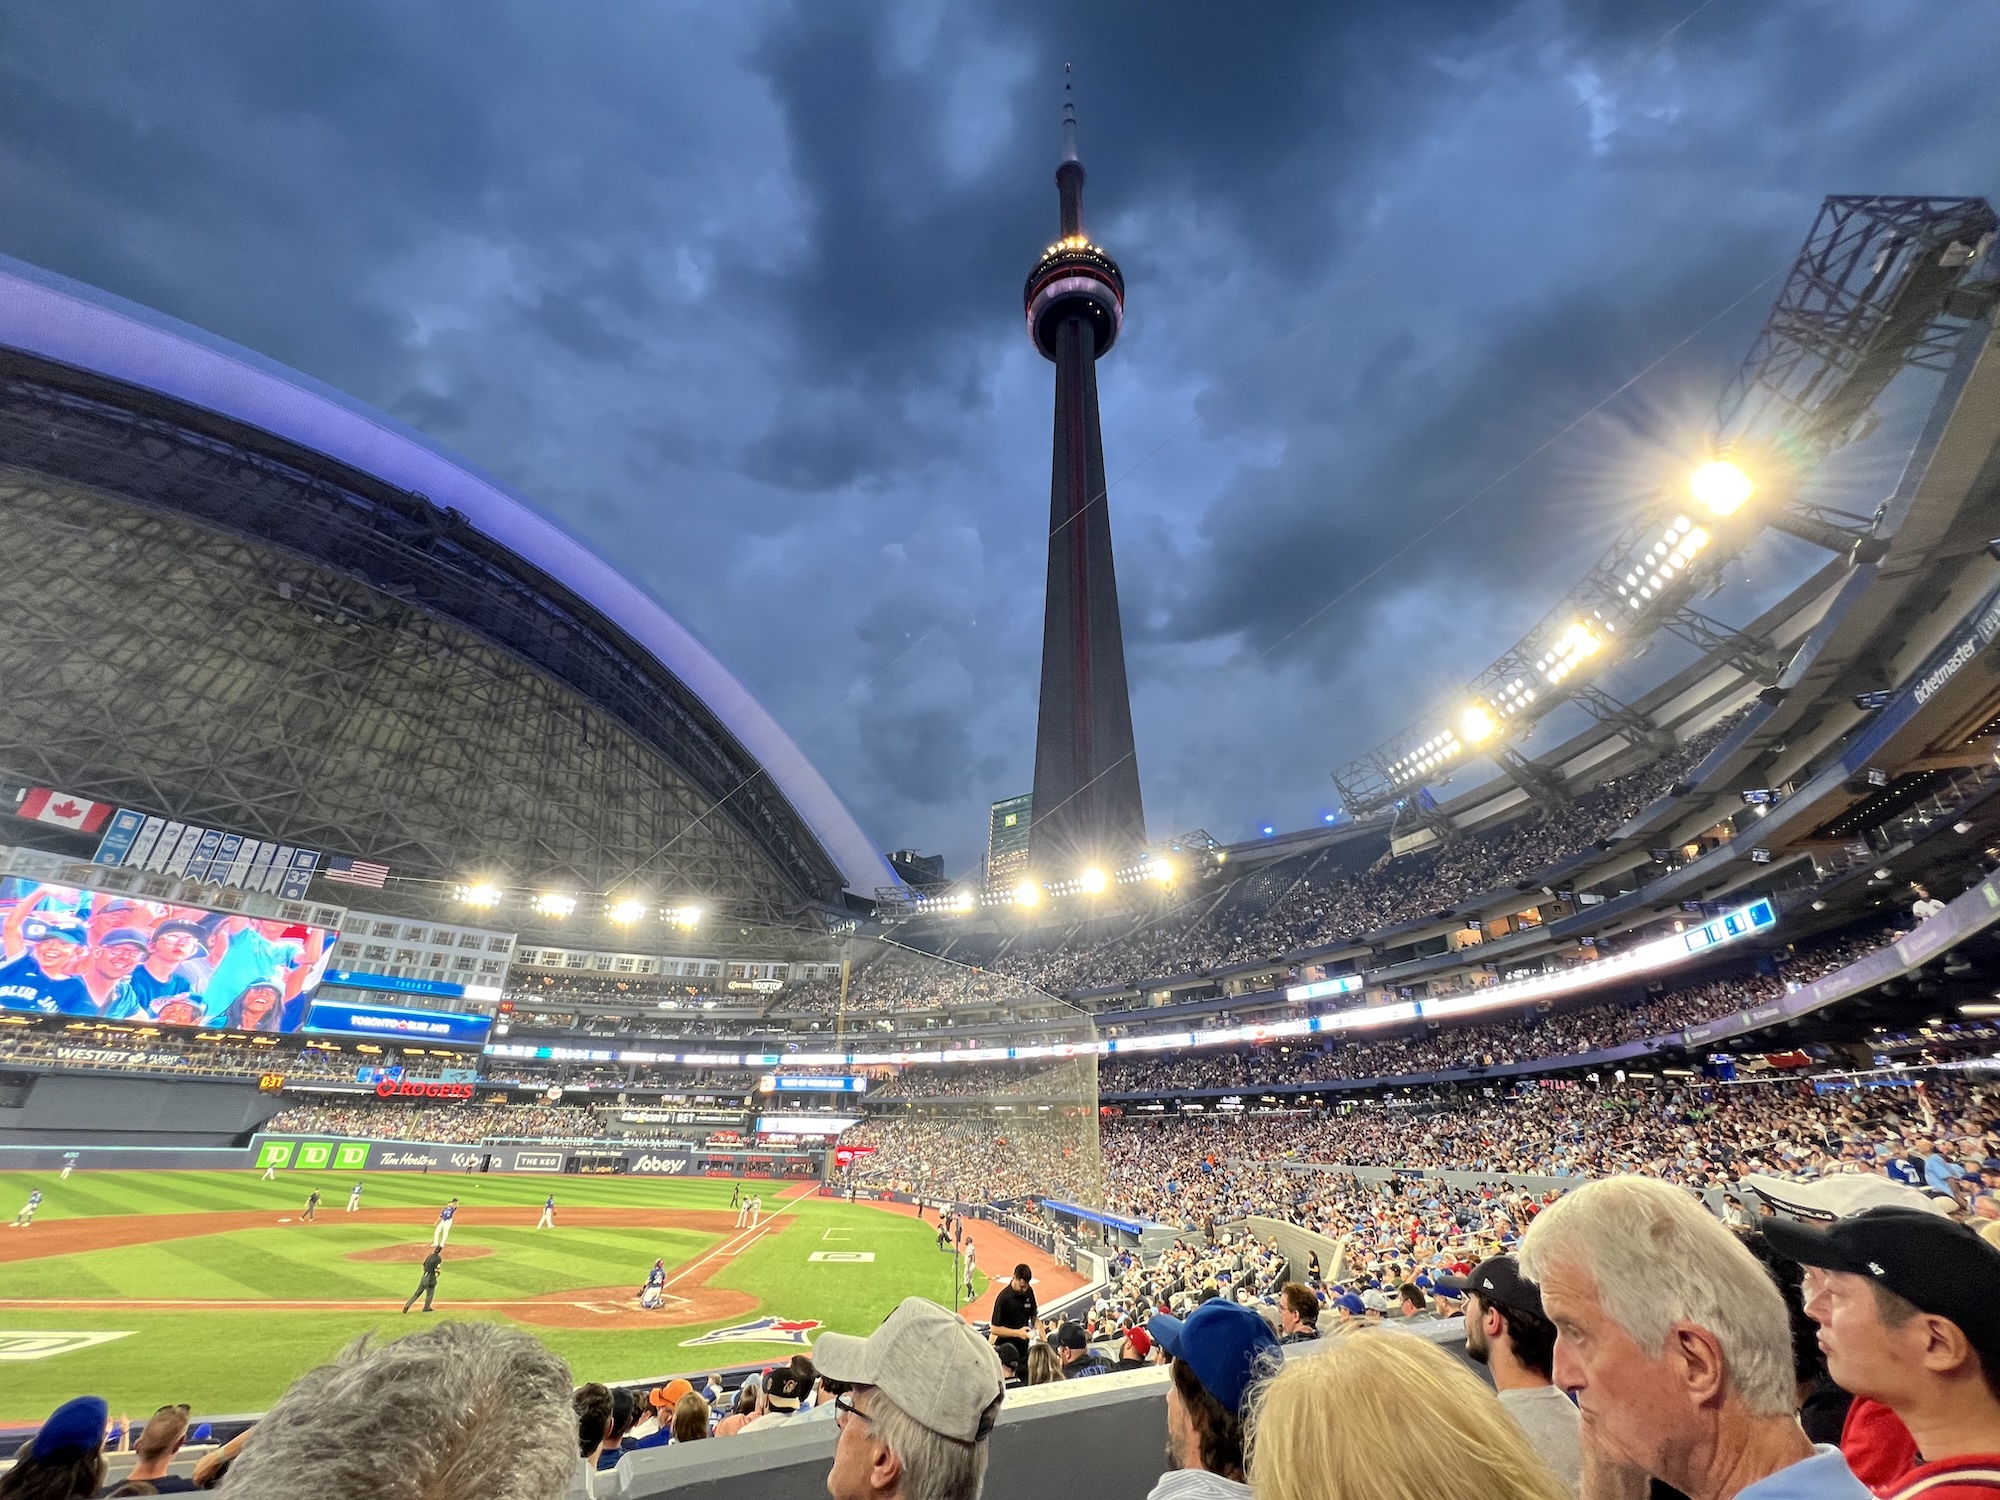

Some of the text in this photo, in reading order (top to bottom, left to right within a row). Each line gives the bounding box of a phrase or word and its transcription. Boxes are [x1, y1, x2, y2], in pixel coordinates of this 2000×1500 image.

[1914, 639, 1976, 704] ticketmaster
[287, 871, 309, 885] 32
[396, 981, 432, 990] TORONTO
[752, 982, 783, 990] ROOFTOP
[351, 1015, 398, 1028] TORONTO
[57, 1047, 180, 1064] WESTJET FLIGHT
[400, 1081, 473, 1098] ROGERS
[621, 1111, 670, 1123] theScore
[677, 1113, 695, 1123] BET
[265, 1146, 289, 1163] TD
[304, 1147, 327, 1163] TD
[341, 1147, 365, 1163] TD
[380, 1153, 399, 1165] Tim
[521, 1157, 557, 1166] THE KEG
[632, 1154, 687, 1174] Sobeys
